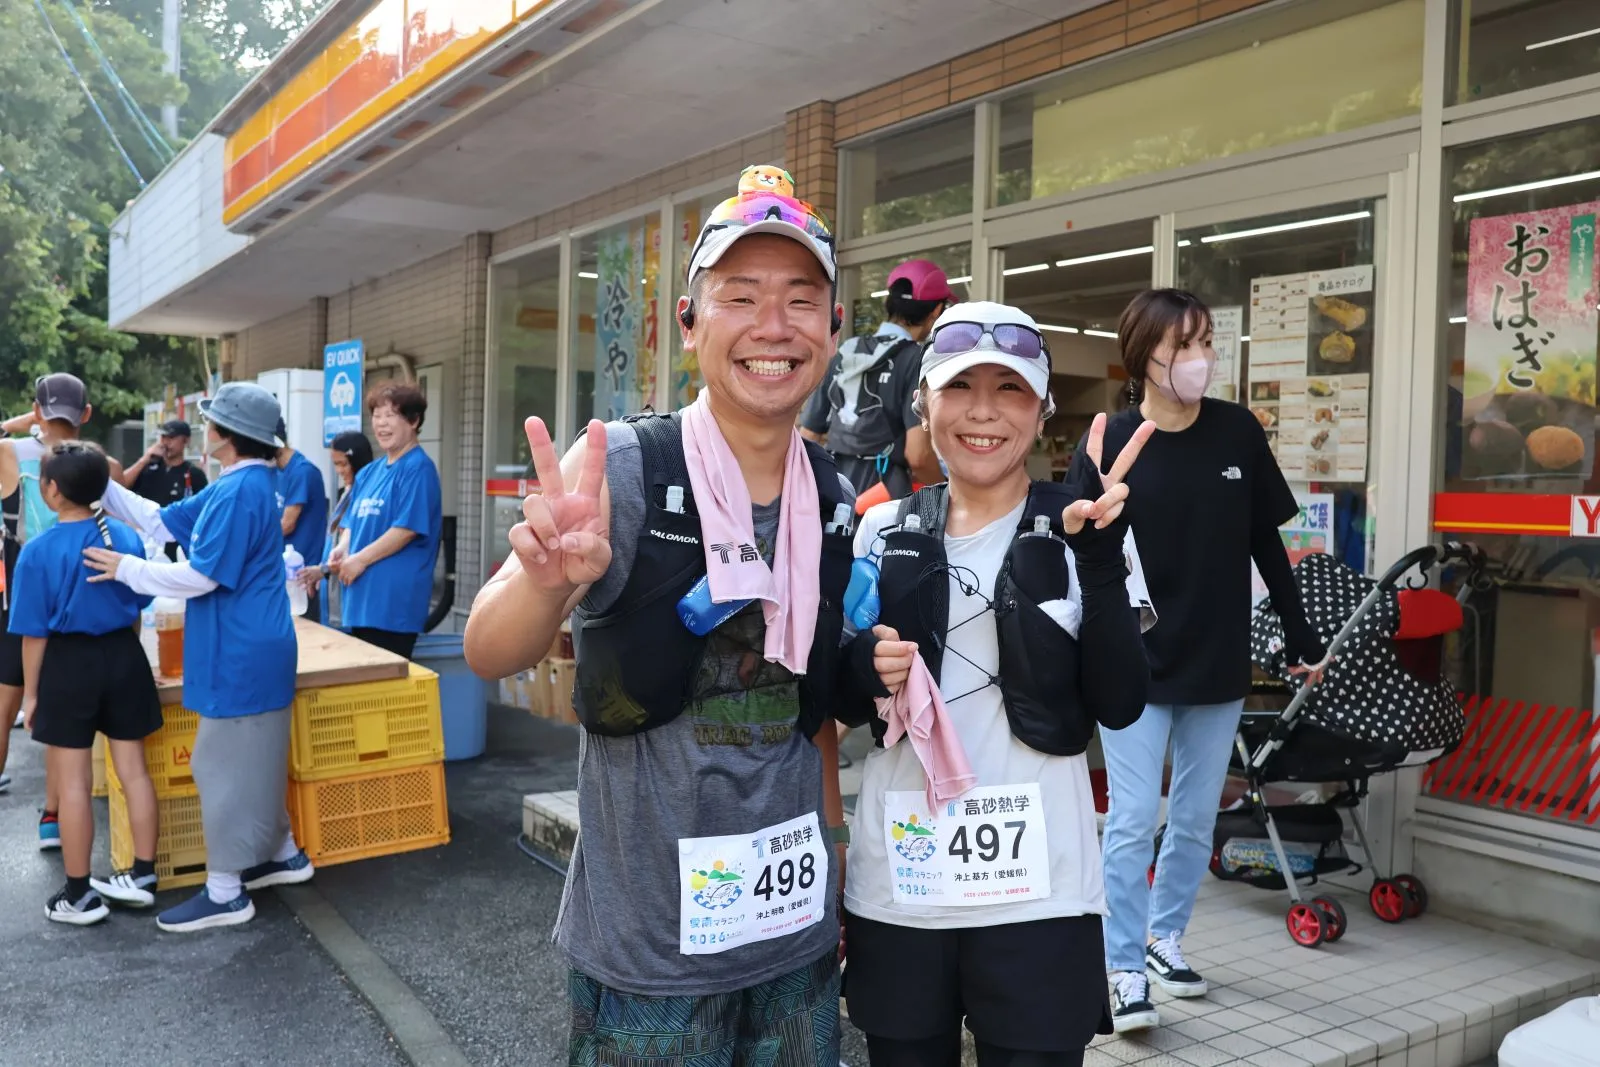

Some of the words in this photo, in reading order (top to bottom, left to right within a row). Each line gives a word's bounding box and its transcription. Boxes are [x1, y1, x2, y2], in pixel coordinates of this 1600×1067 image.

[1492, 225, 1556, 388] おはぎ
[326, 351, 336, 368] EV
[337, 348, 361, 366] QUICK
[650, 529, 699, 544] SALOMON
[738, 543, 760, 563] 高
[964, 794, 1029, 816] 高砂熱学
[769, 825, 813, 855] 高砂熱学
[948, 820, 1027, 863] 497
[753, 852, 816, 902] 498
